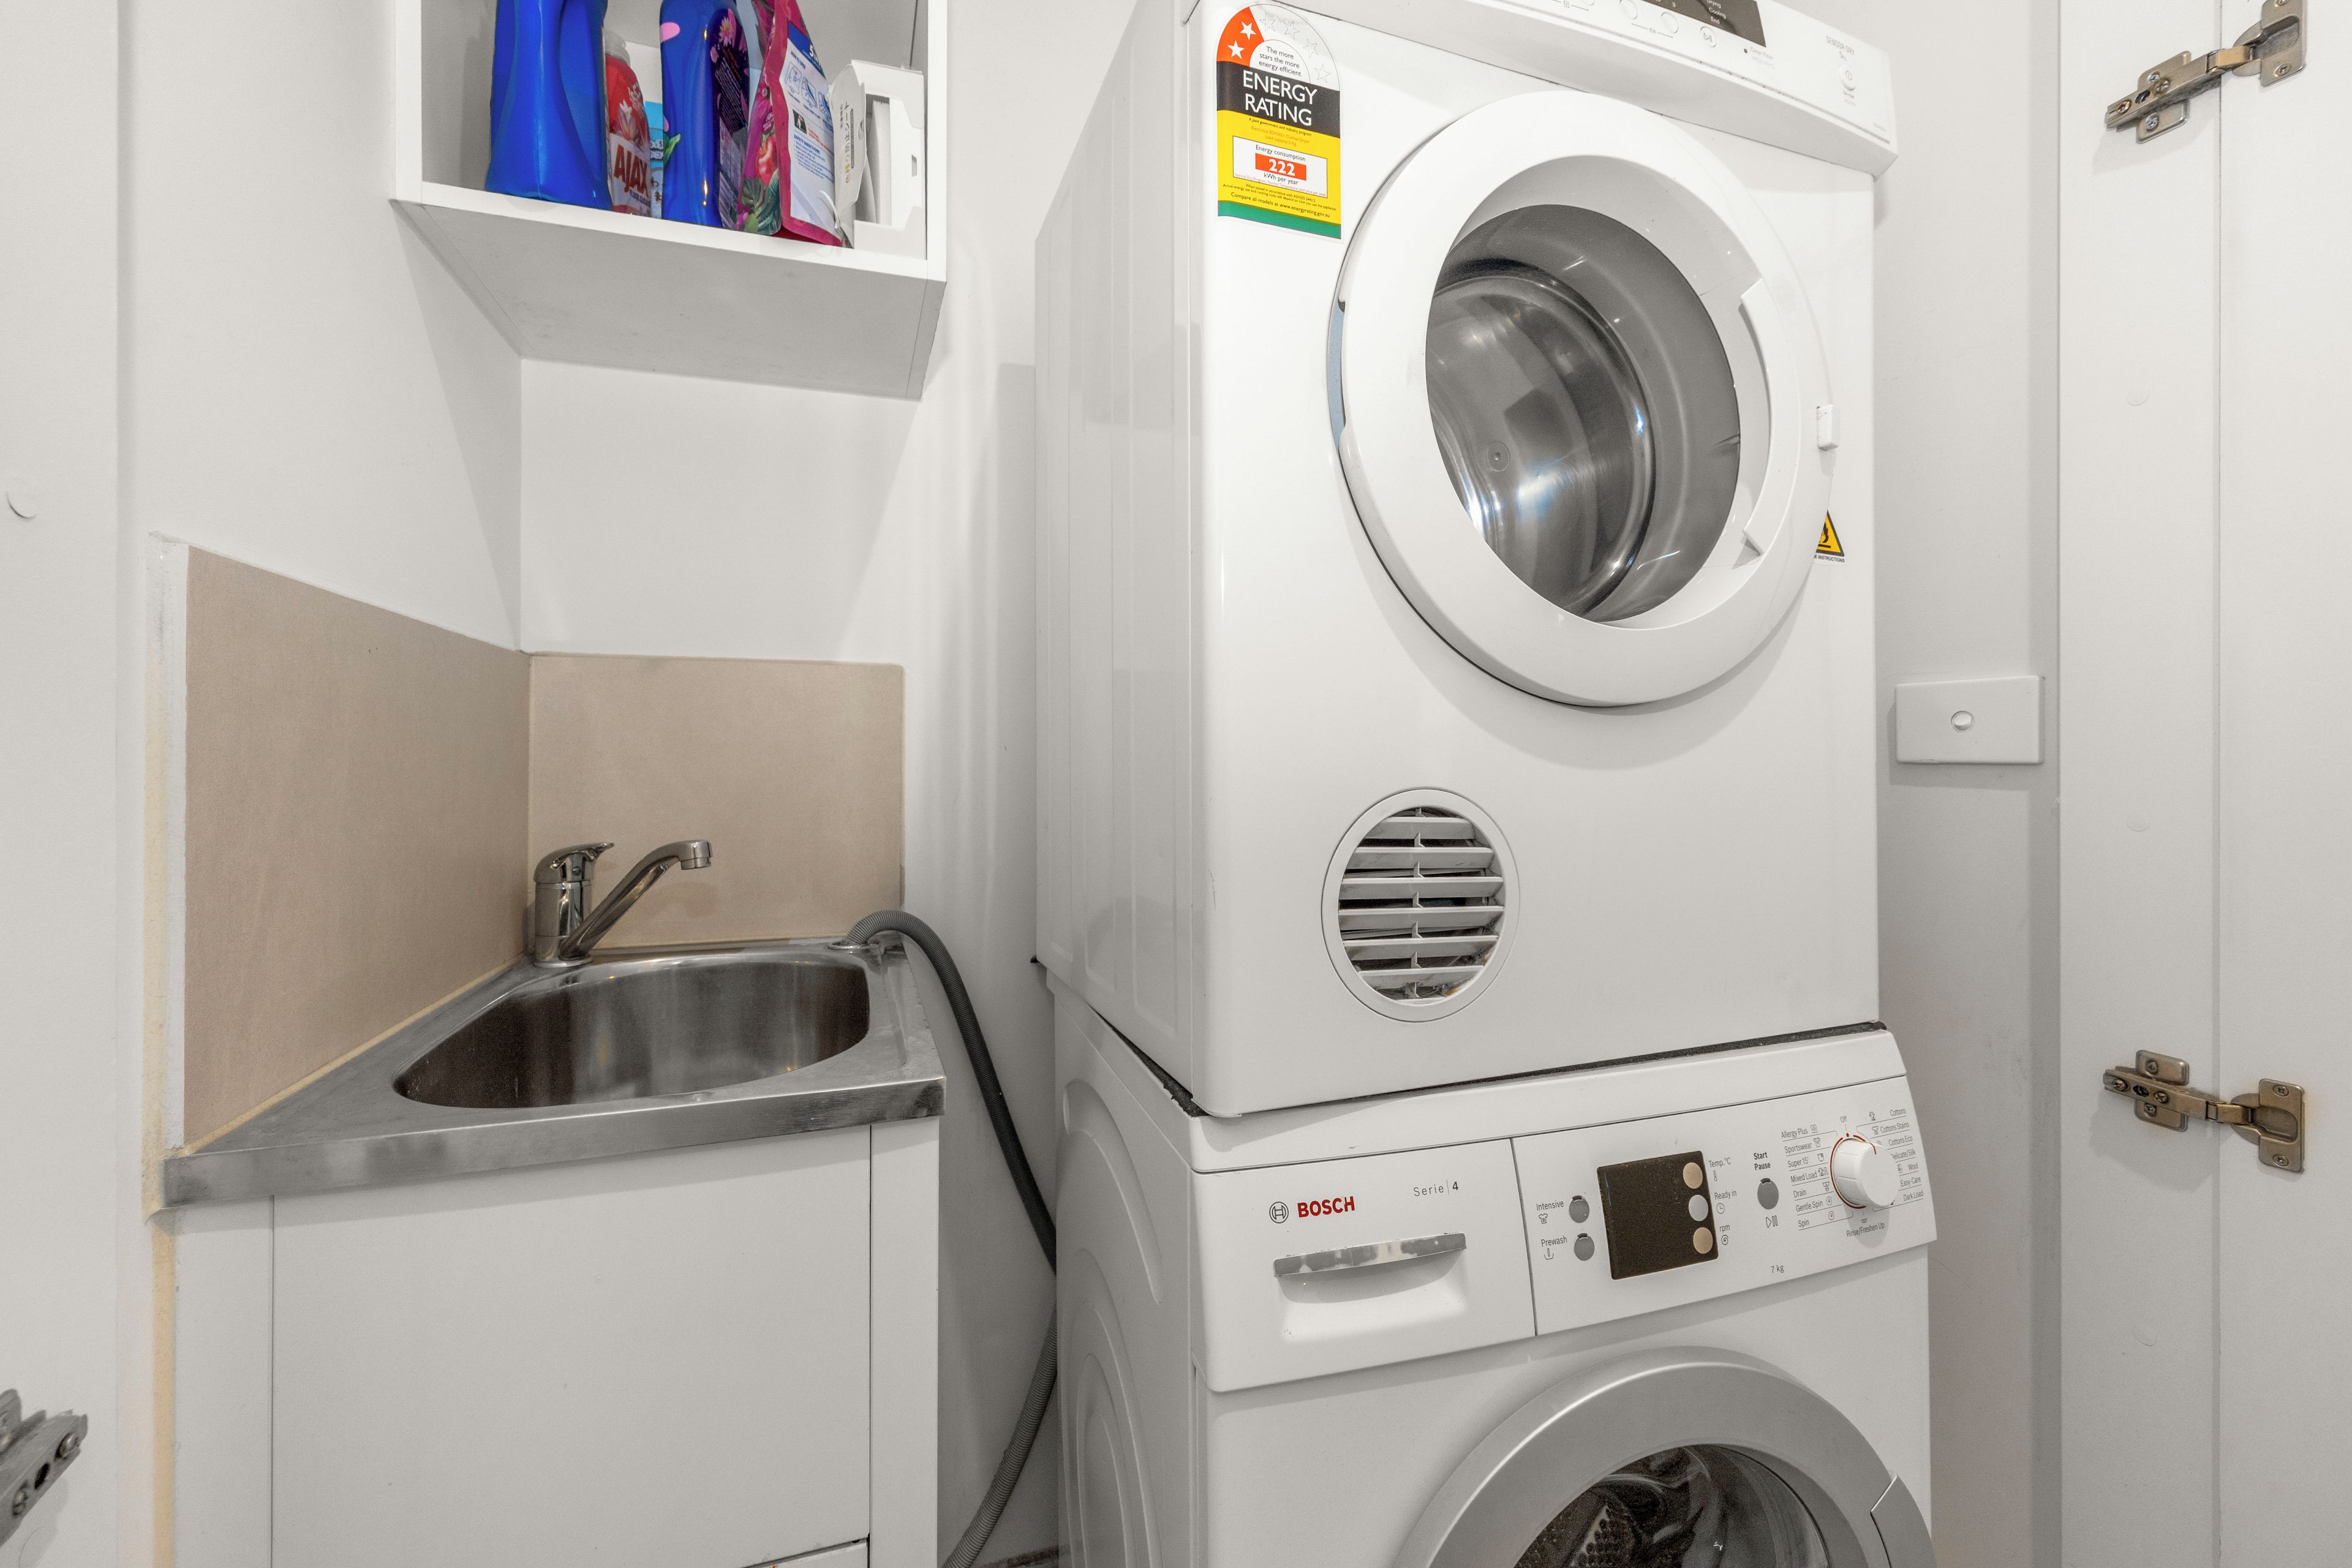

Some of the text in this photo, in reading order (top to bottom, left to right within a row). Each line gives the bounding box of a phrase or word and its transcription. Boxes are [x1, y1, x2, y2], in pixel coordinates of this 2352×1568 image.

[1266, 46, 1277, 55] The
[1259, 61, 1301, 77] energy efficient
[1243, 70, 1317, 105] ENERGY
[1245, 93, 1311, 126] RATING
[1256, 145, 1306, 161] Energy consumption
[614, 143, 649, 198] AJAX
[1269, 159, 1295, 176] 222
[630, 189, 639, 201] FLOOR
[1280, 203, 1330, 217] www.energyrating.gov.au
[1818, 554, 1845, 563] INSTRUCTIONS
[1890, 1107, 1906, 1117] Cottons
[1880, 1121, 1910, 1133] Cottons Stains
[1781, 1128, 1798, 1139] Allergy
[1784, 1142, 1812, 1154] Sportswear
[1888, 1137, 1905, 1147] Cottons
[1754, 1152, 1768, 1160] Start
[1754, 1162, 1771, 1170] Pause
[1788, 1159, 1801, 1168] Super
[1790, 1170, 1817, 1183] Mixed Load
[1901, 1176, 1921, 1187] Easy-Care
[1414, 1181, 1459, 1197] Serie 4
[1793, 1188, 1807, 1198] Drain
[1714, 1191, 1731, 1200] Ready
[1903, 1190, 1924, 1201] Dark Load
[1297, 1196, 1355, 1218] BOSCH
[1536, 1200, 1564, 1211] Intensive
[1796, 1200, 1823, 1212] Gentle Spin
[1798, 1218, 1809, 1227] Spin
[1846, 1221, 1885, 1237] Rinse/Freshen Up
[1541, 1235, 1567, 1248] Prewash
[1776, 1264, 1784, 1273] kg
